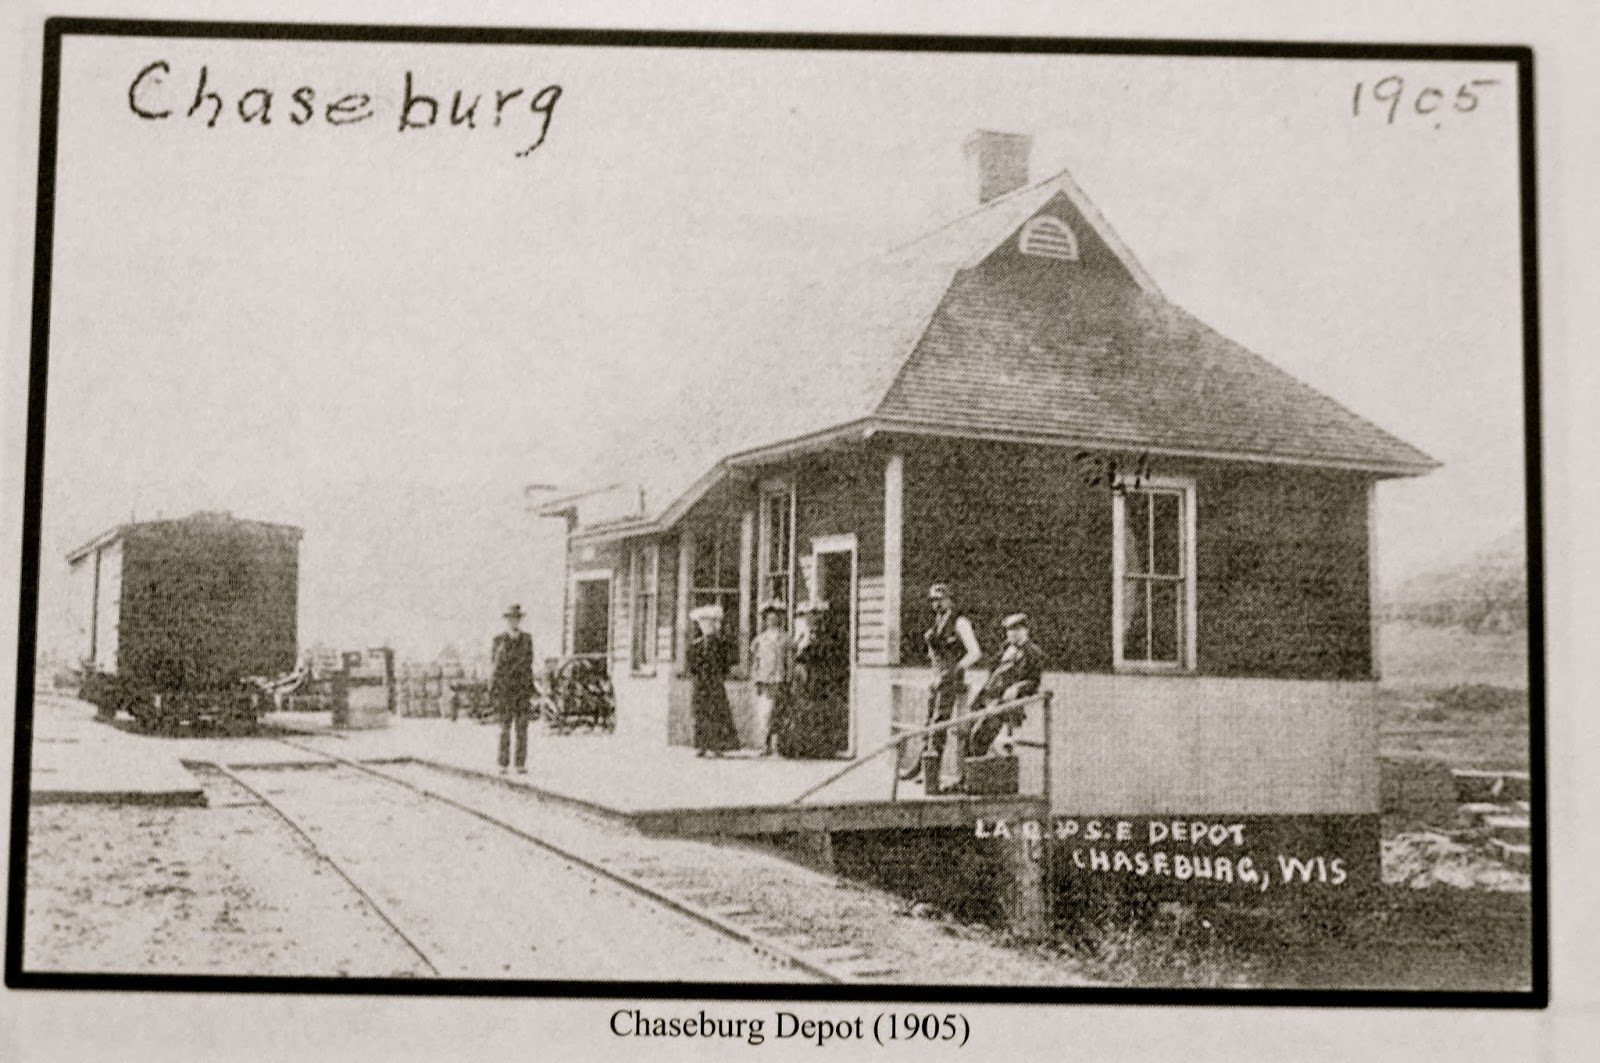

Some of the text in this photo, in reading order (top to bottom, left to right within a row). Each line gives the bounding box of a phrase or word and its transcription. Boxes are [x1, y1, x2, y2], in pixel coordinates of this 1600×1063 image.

[609, 1009, 971, 1047] Chaseburg Depot (1905)
